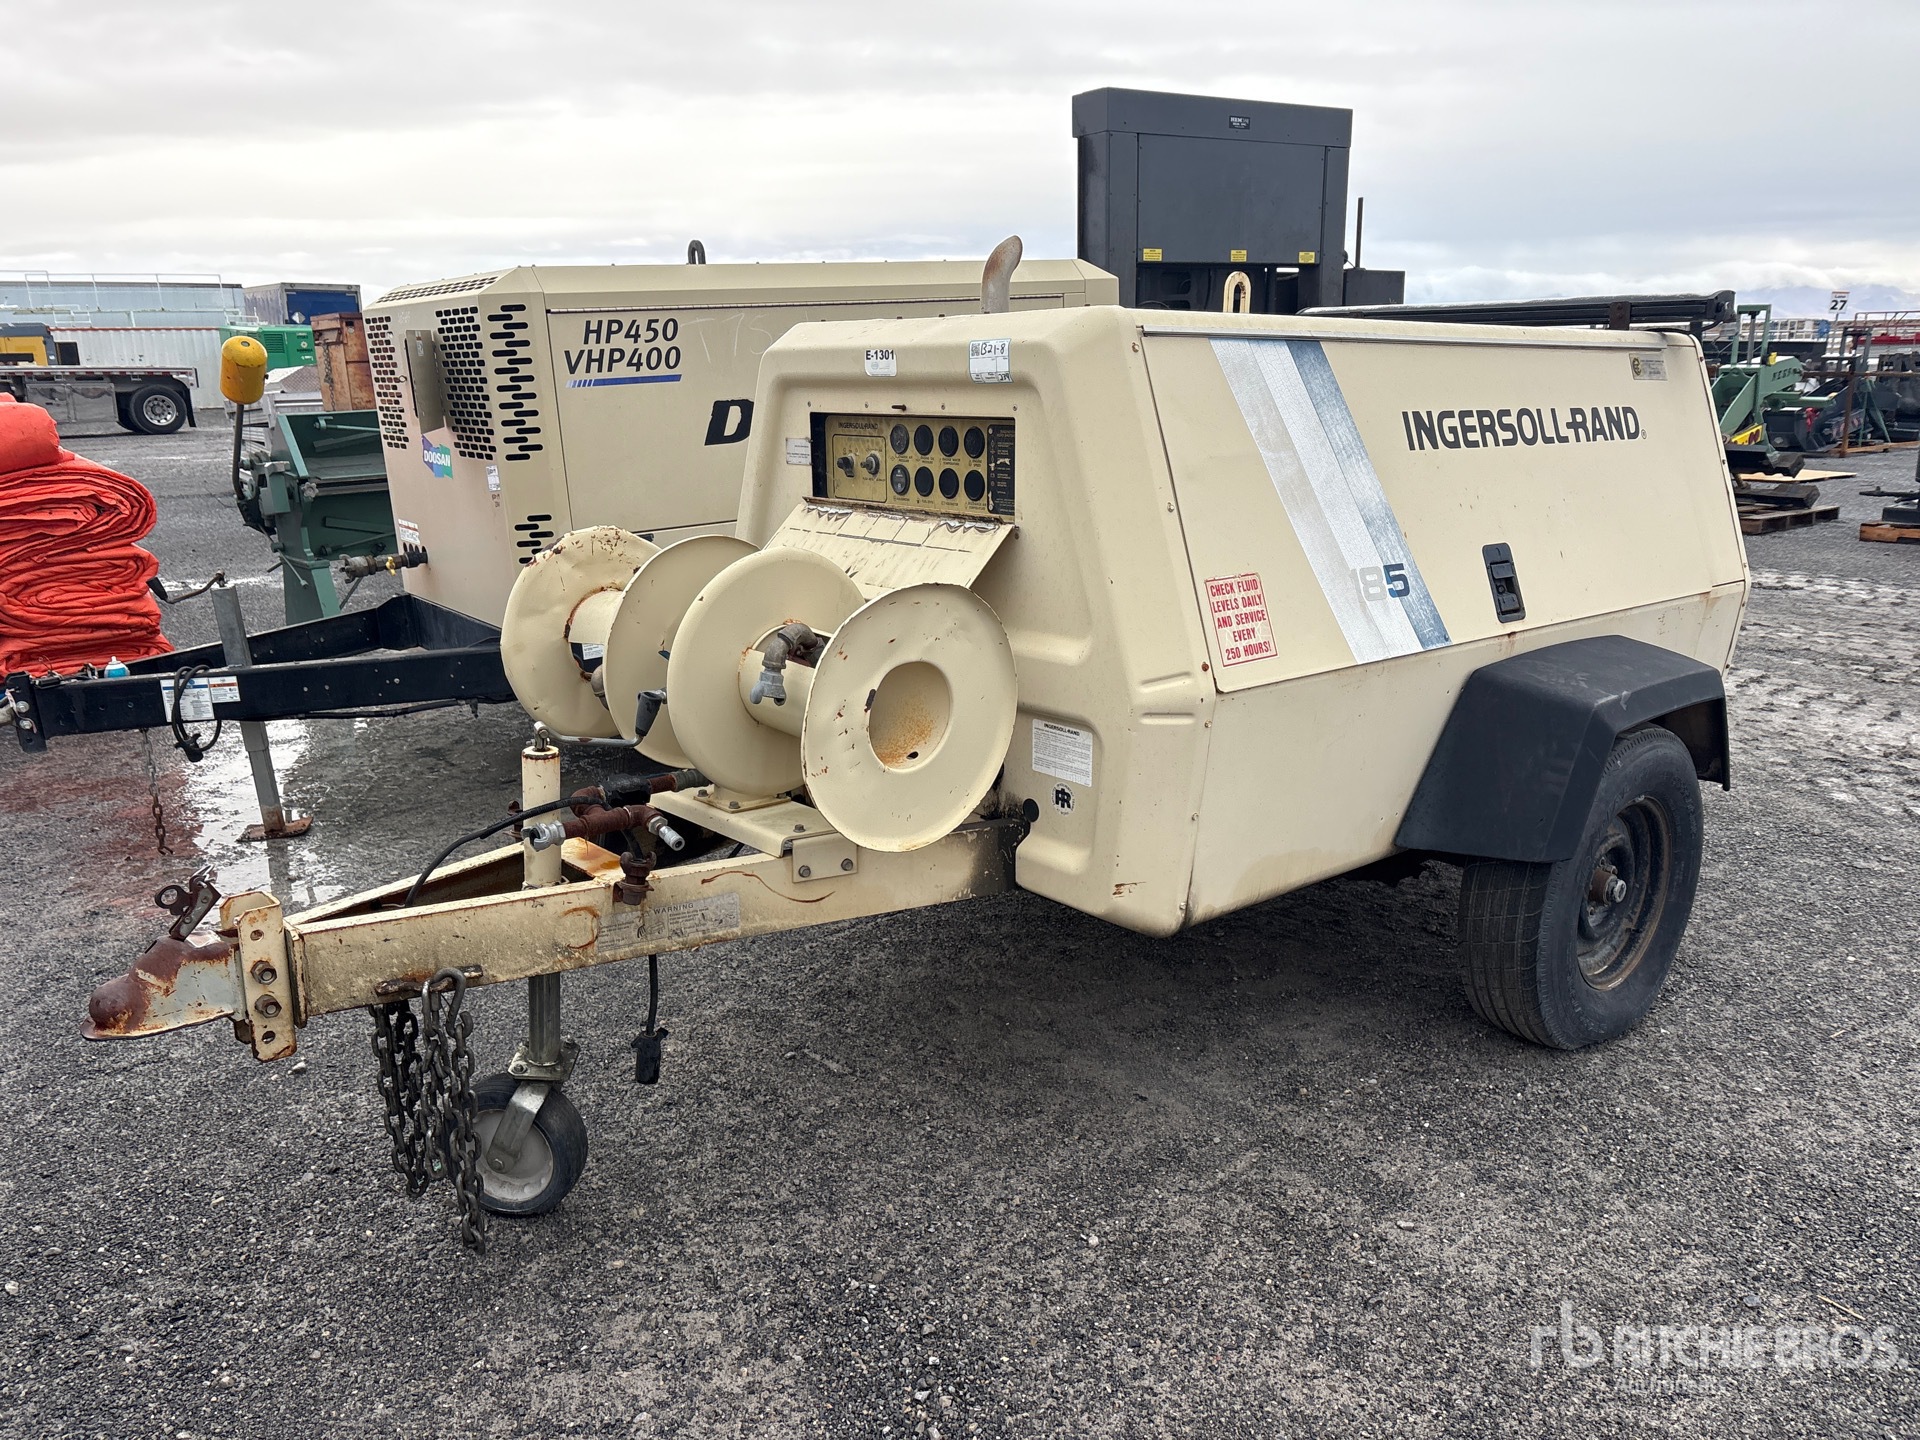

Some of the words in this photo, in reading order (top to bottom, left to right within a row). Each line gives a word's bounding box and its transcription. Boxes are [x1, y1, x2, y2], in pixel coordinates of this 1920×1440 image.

[1829, 299, 1848, 311] 27
[583, 317, 679, 345] HP450
[865, 350, 895, 361] E-1301
[981, 342, 1006, 356] B21-8
[564, 346, 681, 375] VHP400
[1402, 406, 1640, 451] INGERSOLL-RAND
[424, 450, 451, 467] DOOSAN
[1210, 583, 1235, 597] CHECK
[1237, 579, 1258, 592] FLUID
[1351, 563, 1410, 601] 185
[1212, 598, 1239, 613] LEVELS
[1241, 594, 1263, 608] DAILY
[1217, 615, 1232, 629] AND
[1235, 609, 1266, 625] SERVICE
[1233, 627, 1256, 642] EVERY
[1226, 646, 1241, 660] 250
[1243, 641, 1272, 656] HOURS!
[654, 903, 694, 915] WARNING
